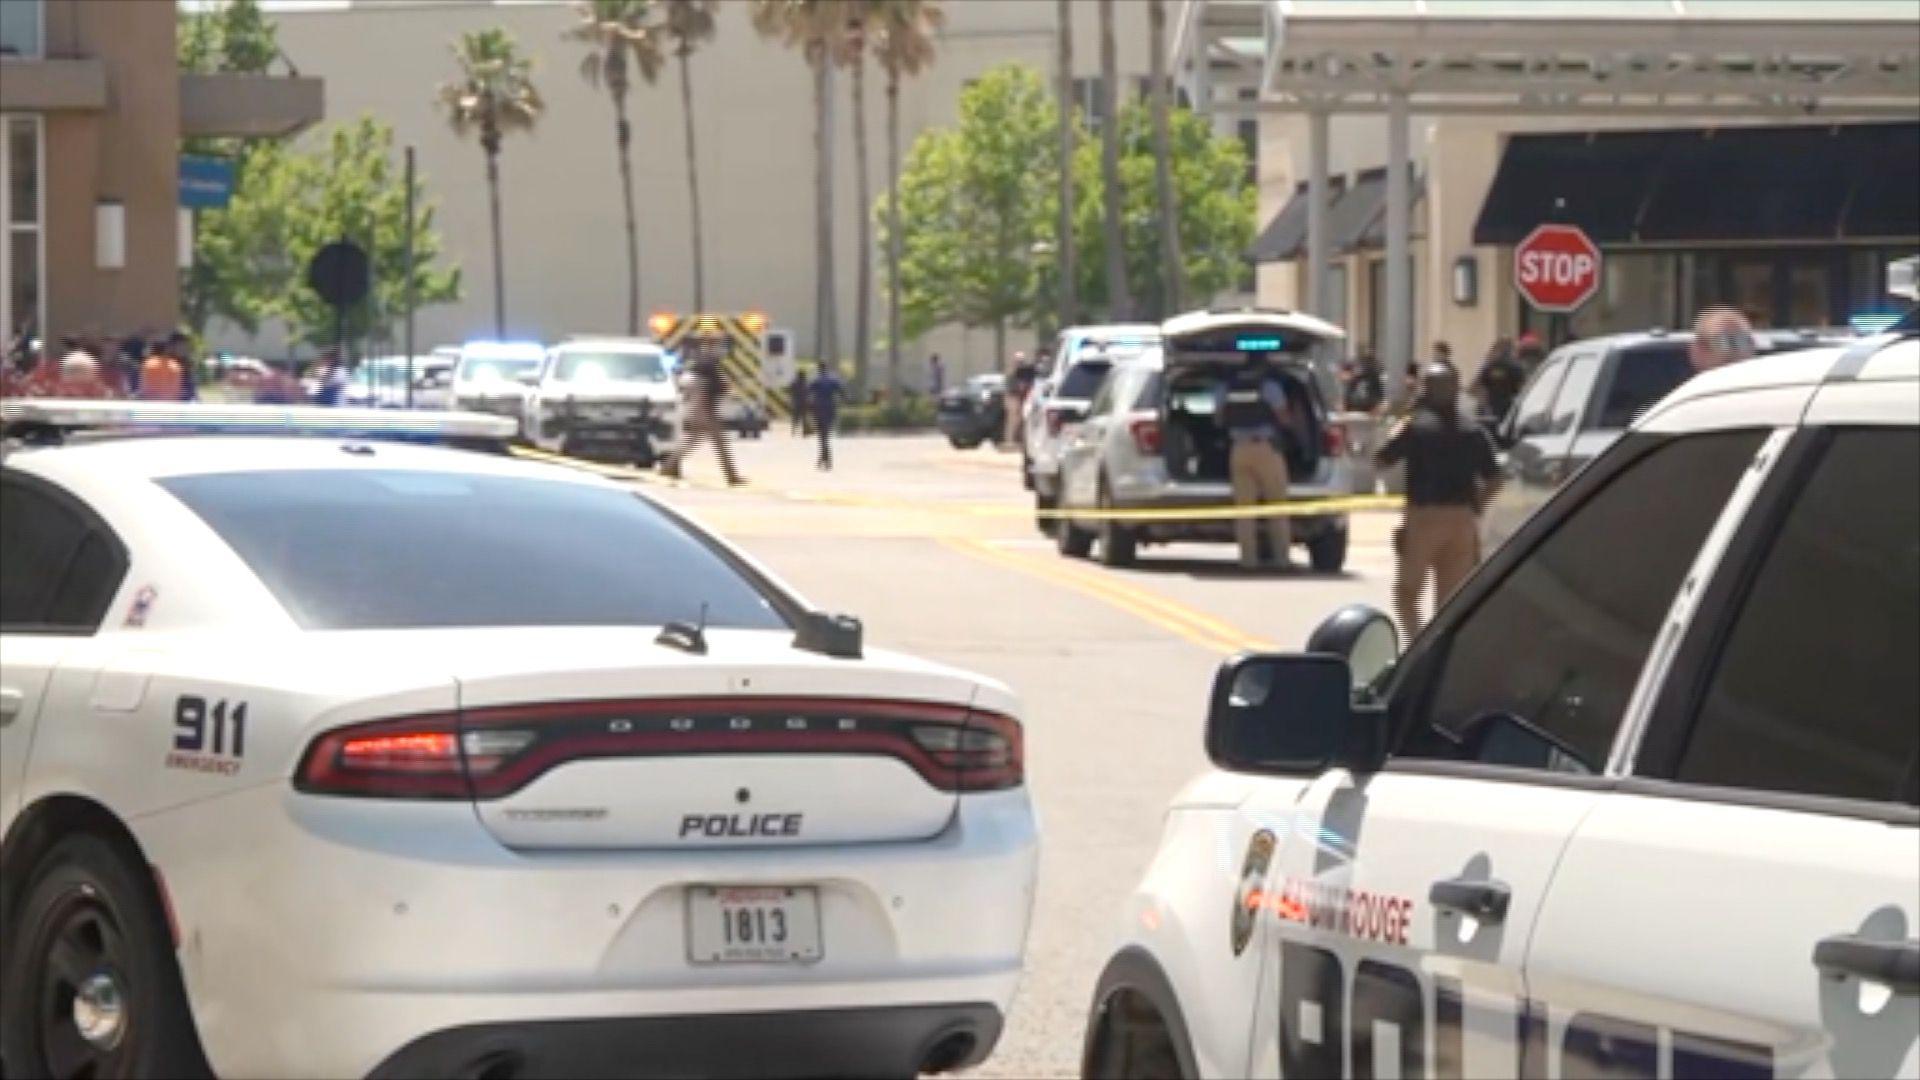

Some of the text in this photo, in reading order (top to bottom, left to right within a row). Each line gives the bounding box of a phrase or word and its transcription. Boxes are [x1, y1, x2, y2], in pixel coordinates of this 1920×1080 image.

[1521, 251, 1593, 286] STOP
[174, 694, 248, 758] 911
[608, 717, 857, 733] DODGE
[678, 813, 803, 838] POLICE
[722, 906, 789, 944] 1813
[1341, 888, 1414, 946] ROUGE
